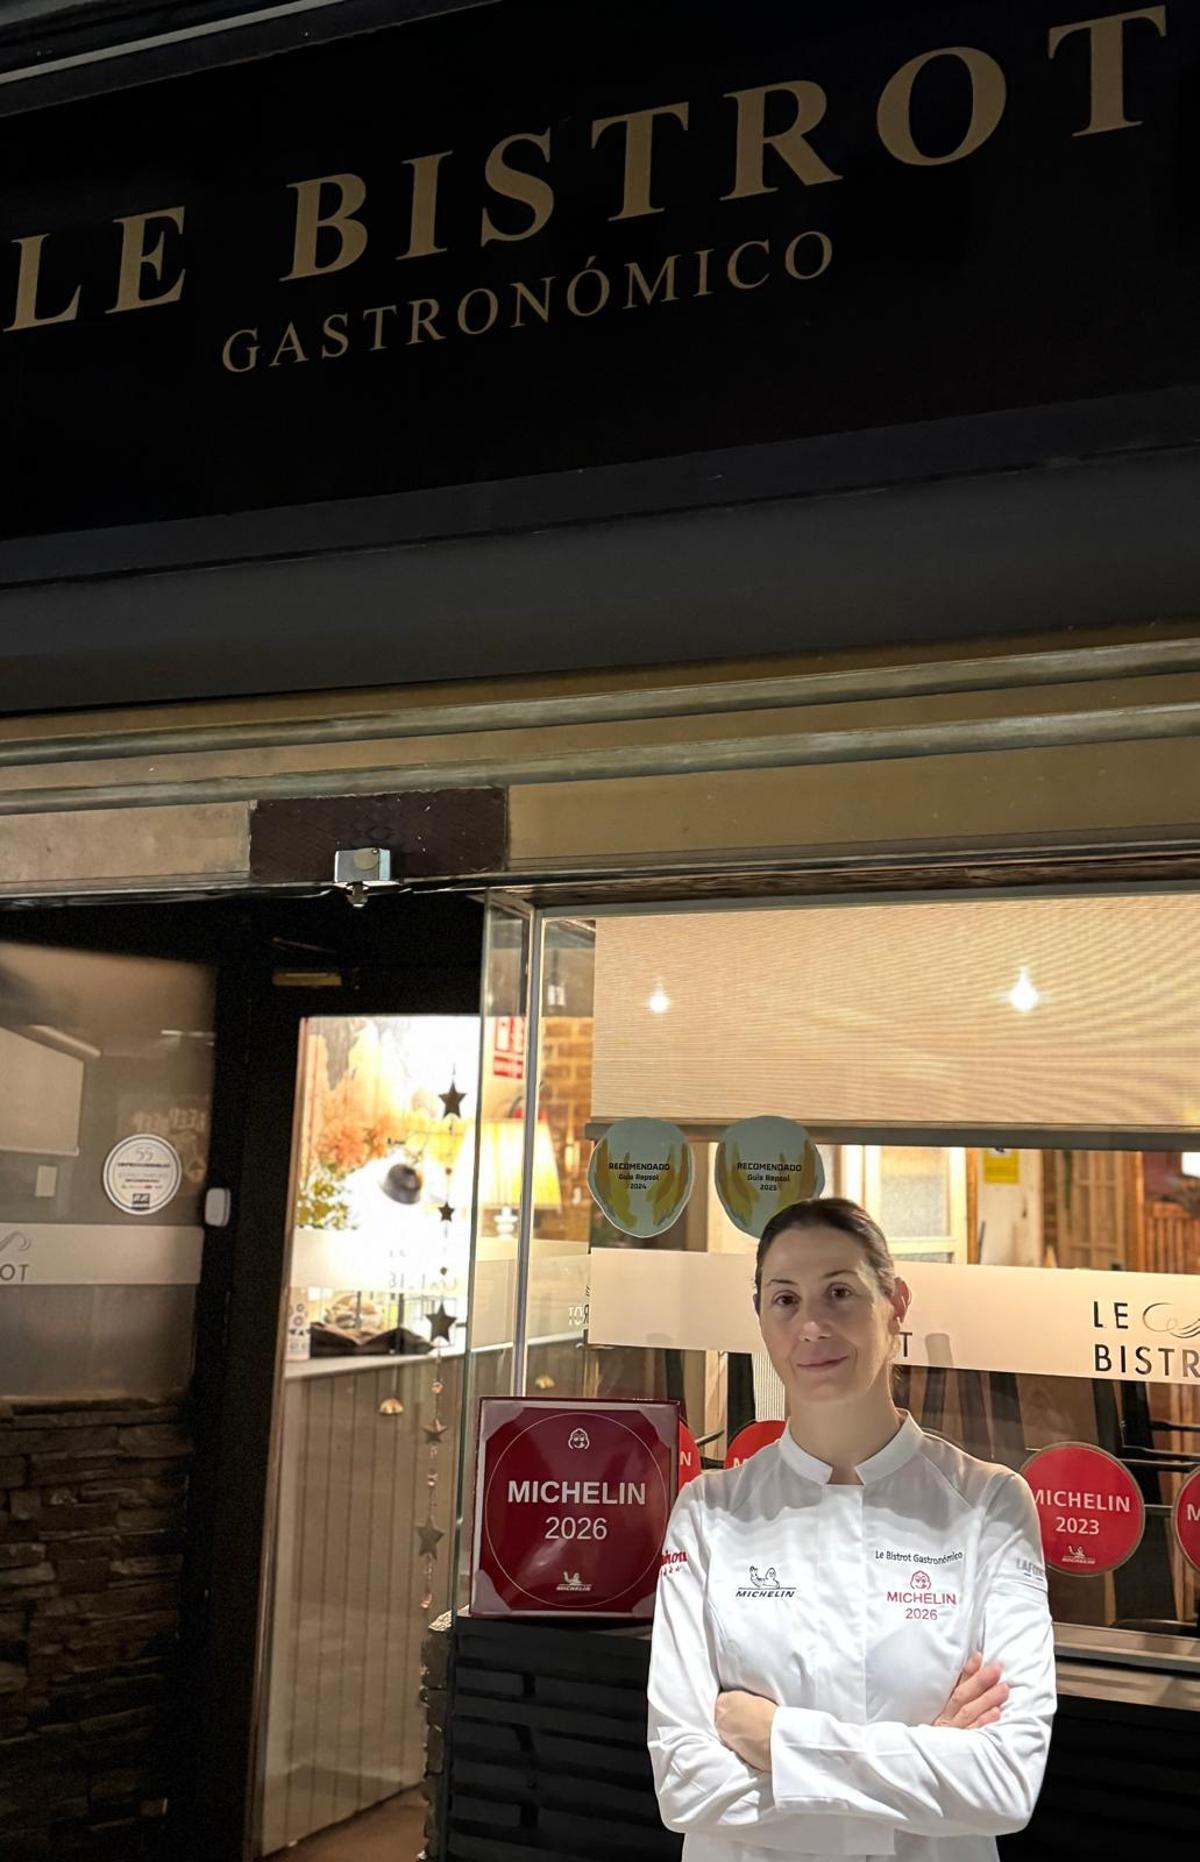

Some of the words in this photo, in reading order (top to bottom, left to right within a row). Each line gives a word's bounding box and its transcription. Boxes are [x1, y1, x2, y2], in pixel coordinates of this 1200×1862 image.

[3, 205, 187, 332] LE
[279, 5, 1168, 283] BISTROT
[222, 231, 833, 373] GASTRONÓMICO
[609, 1162, 670, 1171] RECOMENDADO
[737, 1162, 802, 1172] RECOMENDADO
[1093, 1300, 1129, 1330] LE
[507, 1480, 646, 1505] MICHELIN
[544, 1517, 608, 1540] 2026
[1055, 1516, 1100, 1535] 2023
[875, 1550, 885, 1559] Le
[886, 1551, 912, 1562] Bistrot
[736, 1590, 795, 1598] MICHELIN
[887, 1591, 957, 1605] MICHELIN
[905, 1607, 938, 1621] 2026
